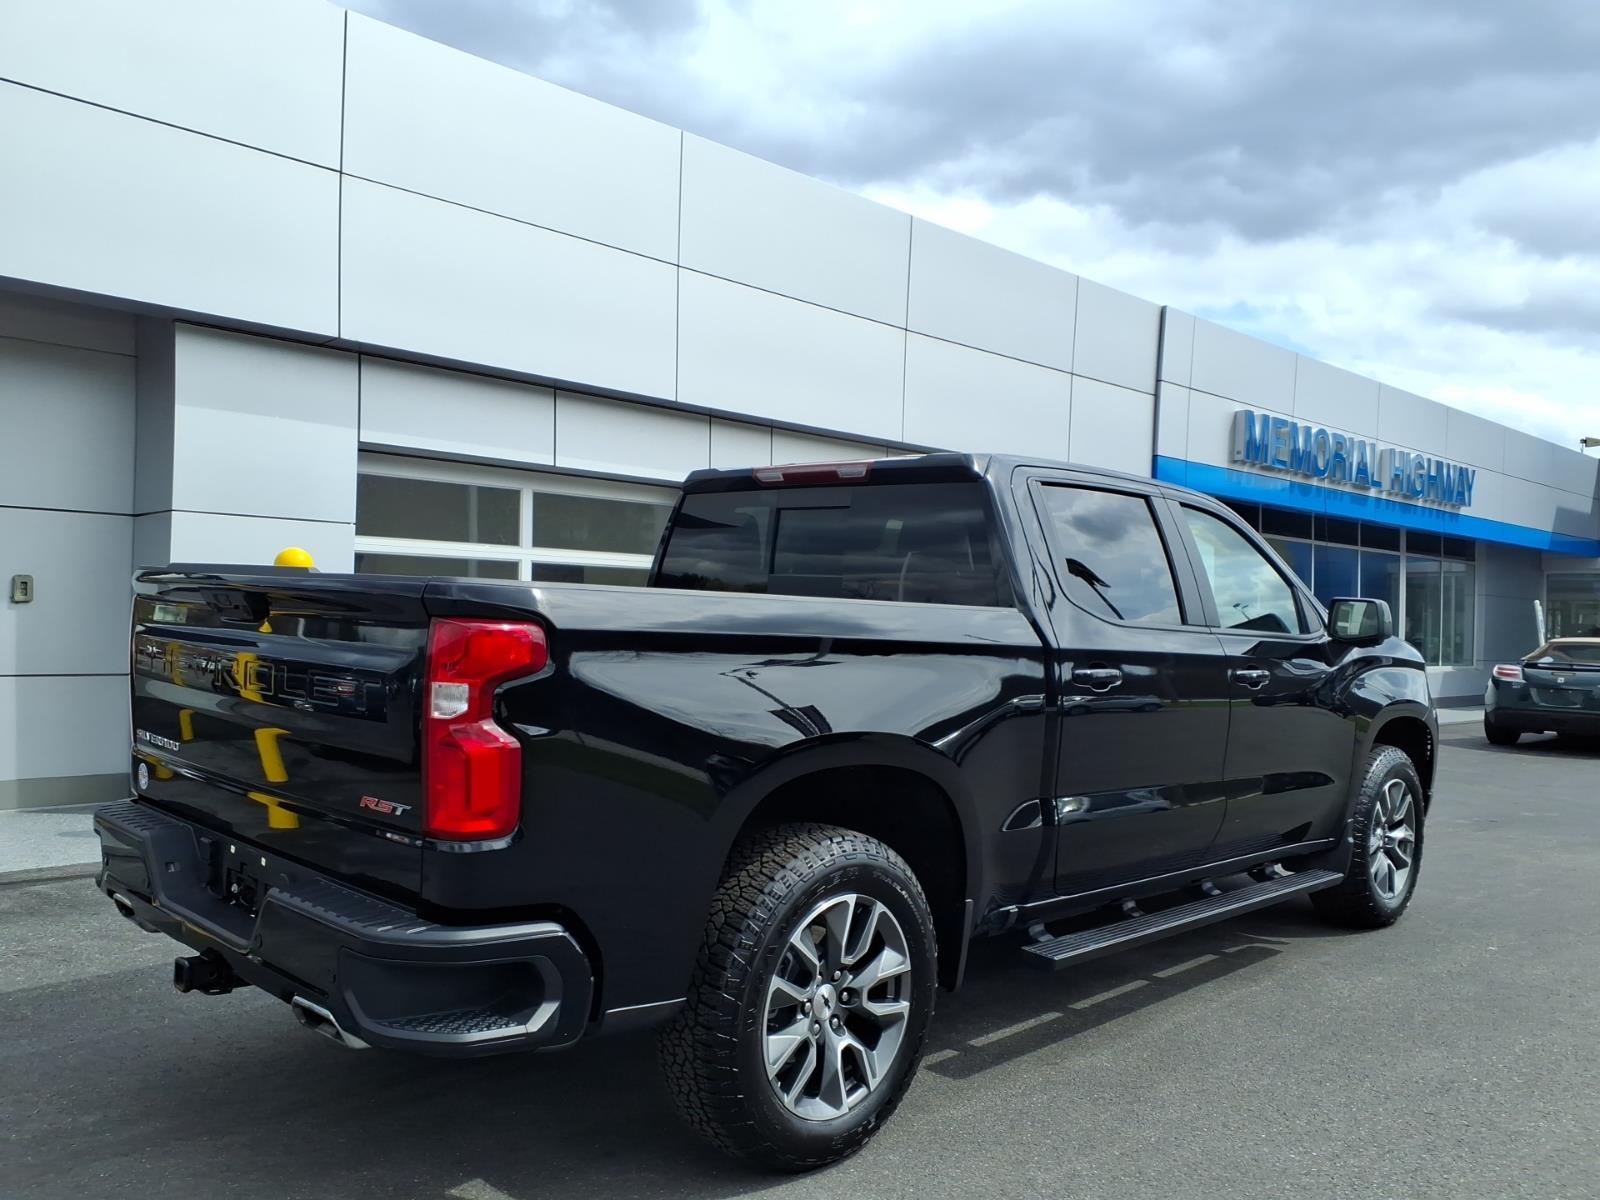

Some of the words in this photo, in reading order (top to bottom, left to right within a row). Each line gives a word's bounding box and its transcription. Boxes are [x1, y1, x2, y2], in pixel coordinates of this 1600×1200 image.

[1234, 409, 1382, 490] MEMORIAL
[1383, 447, 1476, 507] HIGHWAY
[359, 795, 412, 816] RST
